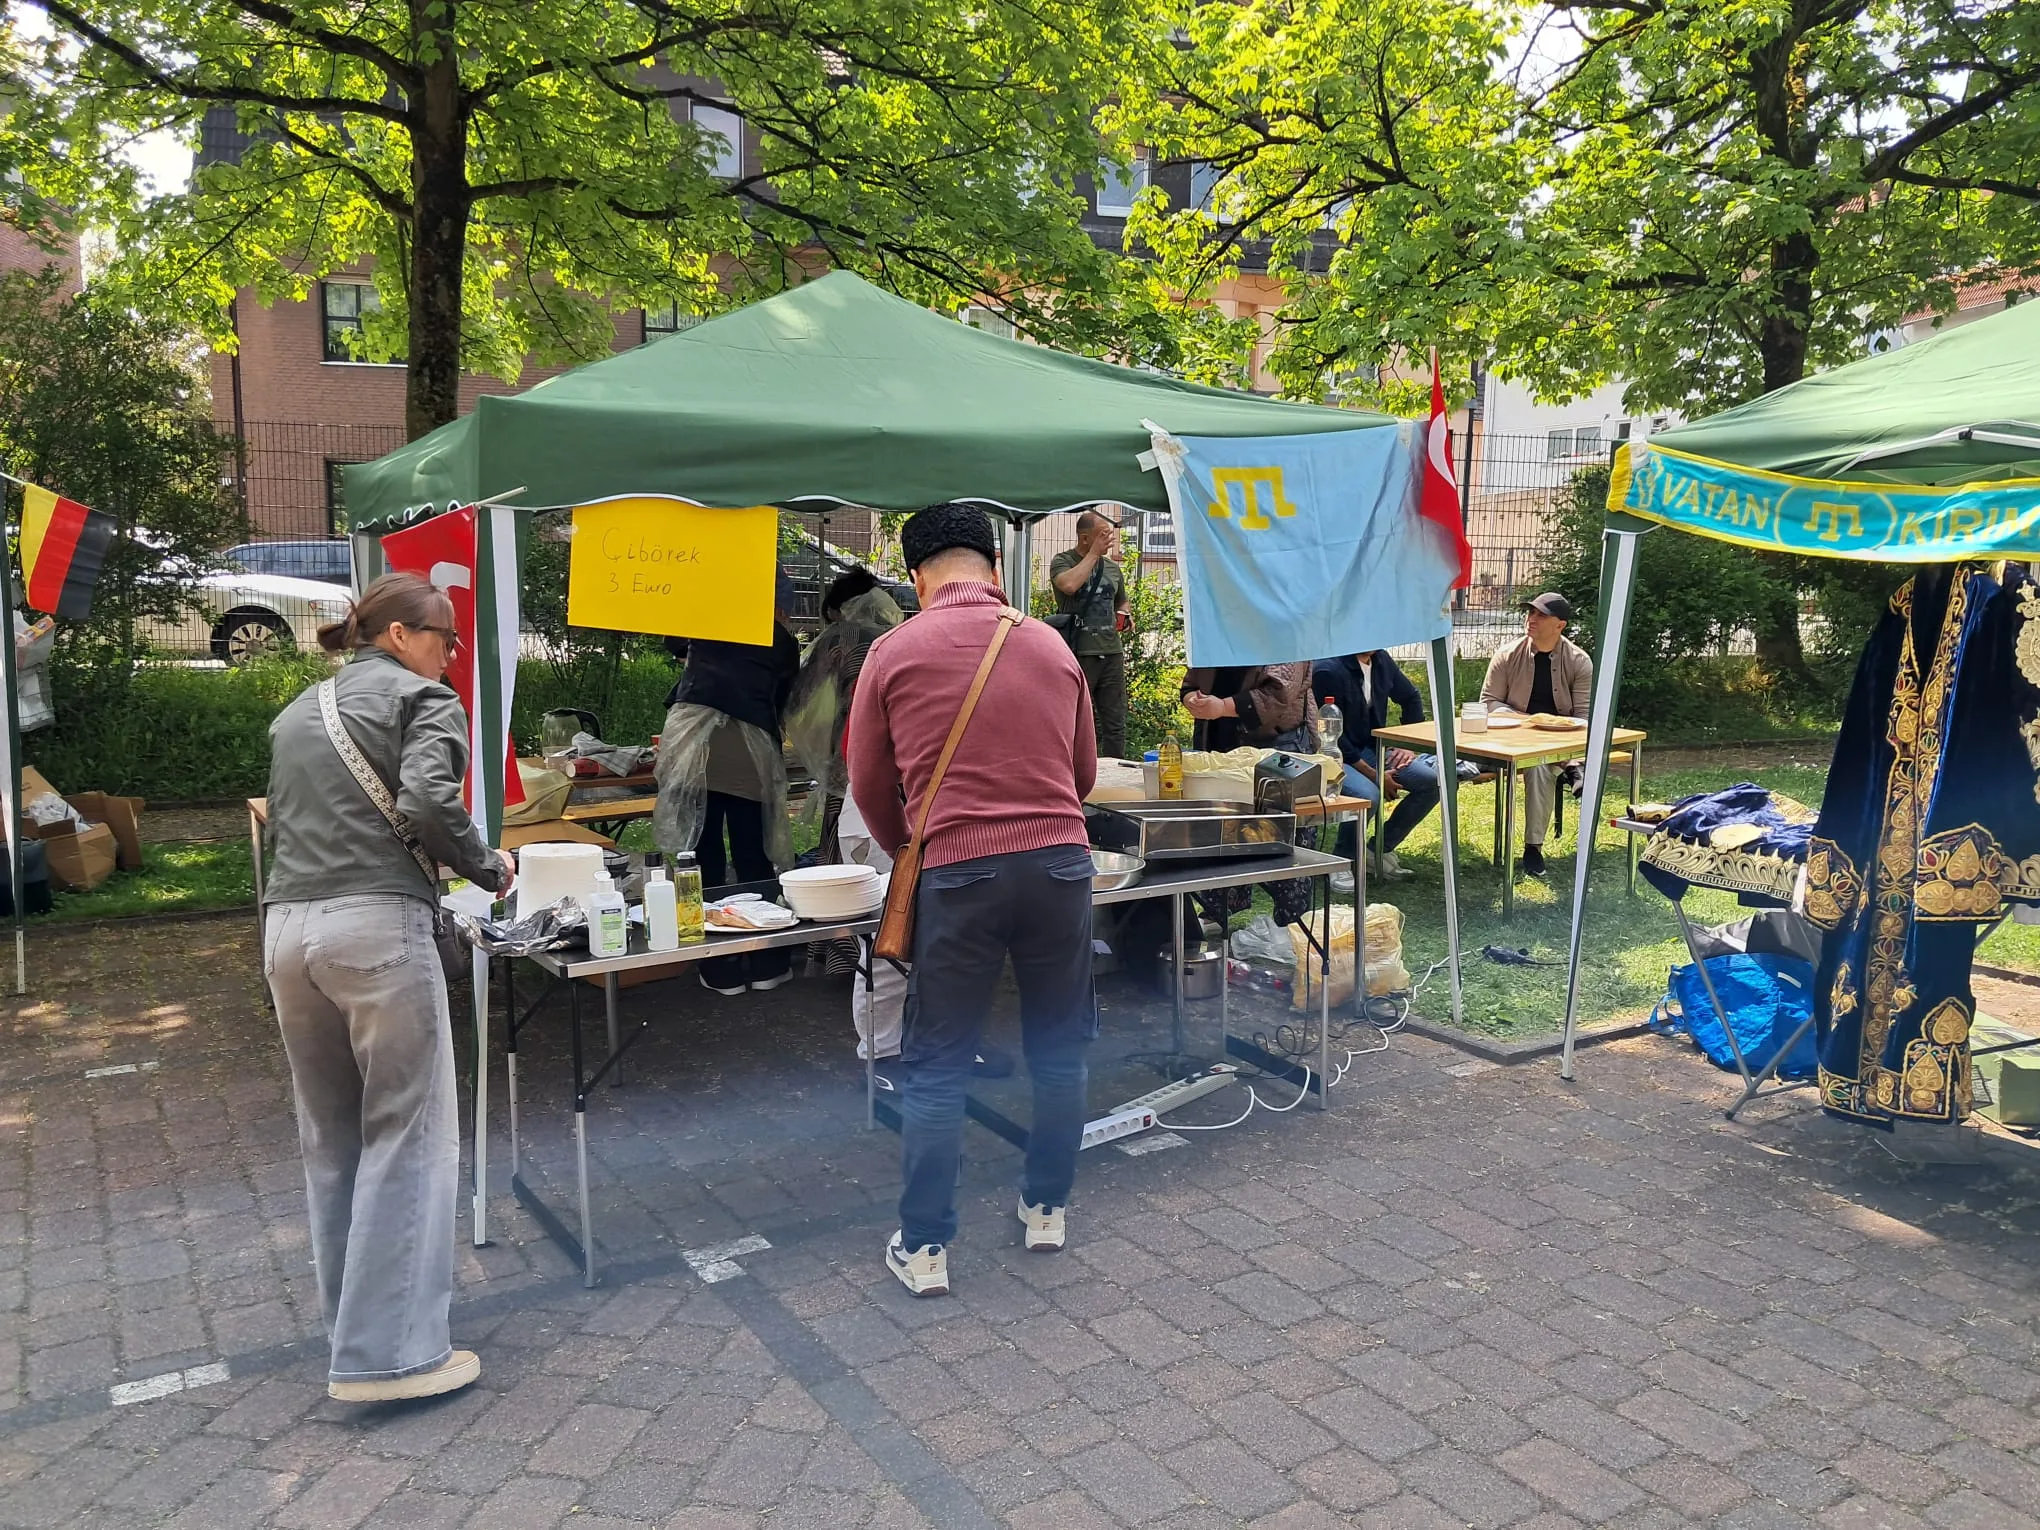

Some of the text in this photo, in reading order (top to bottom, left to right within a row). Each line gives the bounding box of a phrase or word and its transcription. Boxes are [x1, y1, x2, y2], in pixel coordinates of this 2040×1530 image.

[1661, 473, 1770, 530] VATAN
[608, 572, 672, 595] 3 Euro
